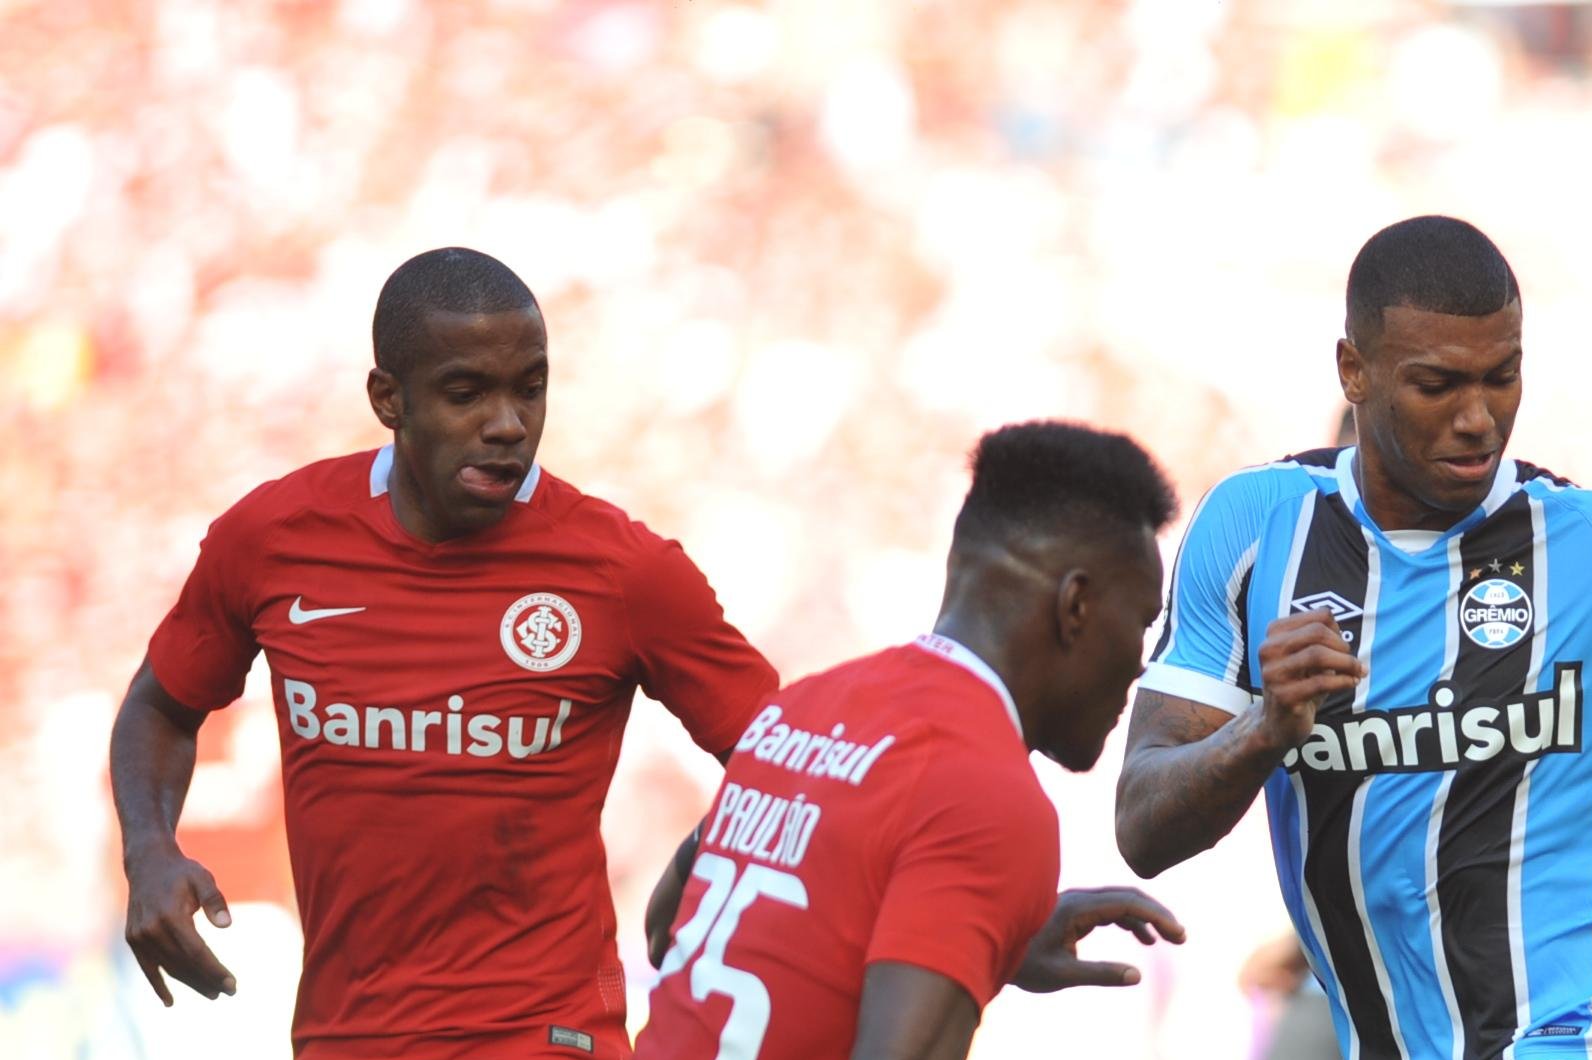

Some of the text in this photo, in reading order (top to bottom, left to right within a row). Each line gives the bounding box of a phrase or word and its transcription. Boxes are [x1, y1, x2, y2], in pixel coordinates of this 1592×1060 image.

[1464, 604, 1529, 623] GRÊMIO
[283, 678, 572, 760] Banrisul
[734, 704, 897, 786] Banrisul
[1283, 669, 1577, 772] anrisul
